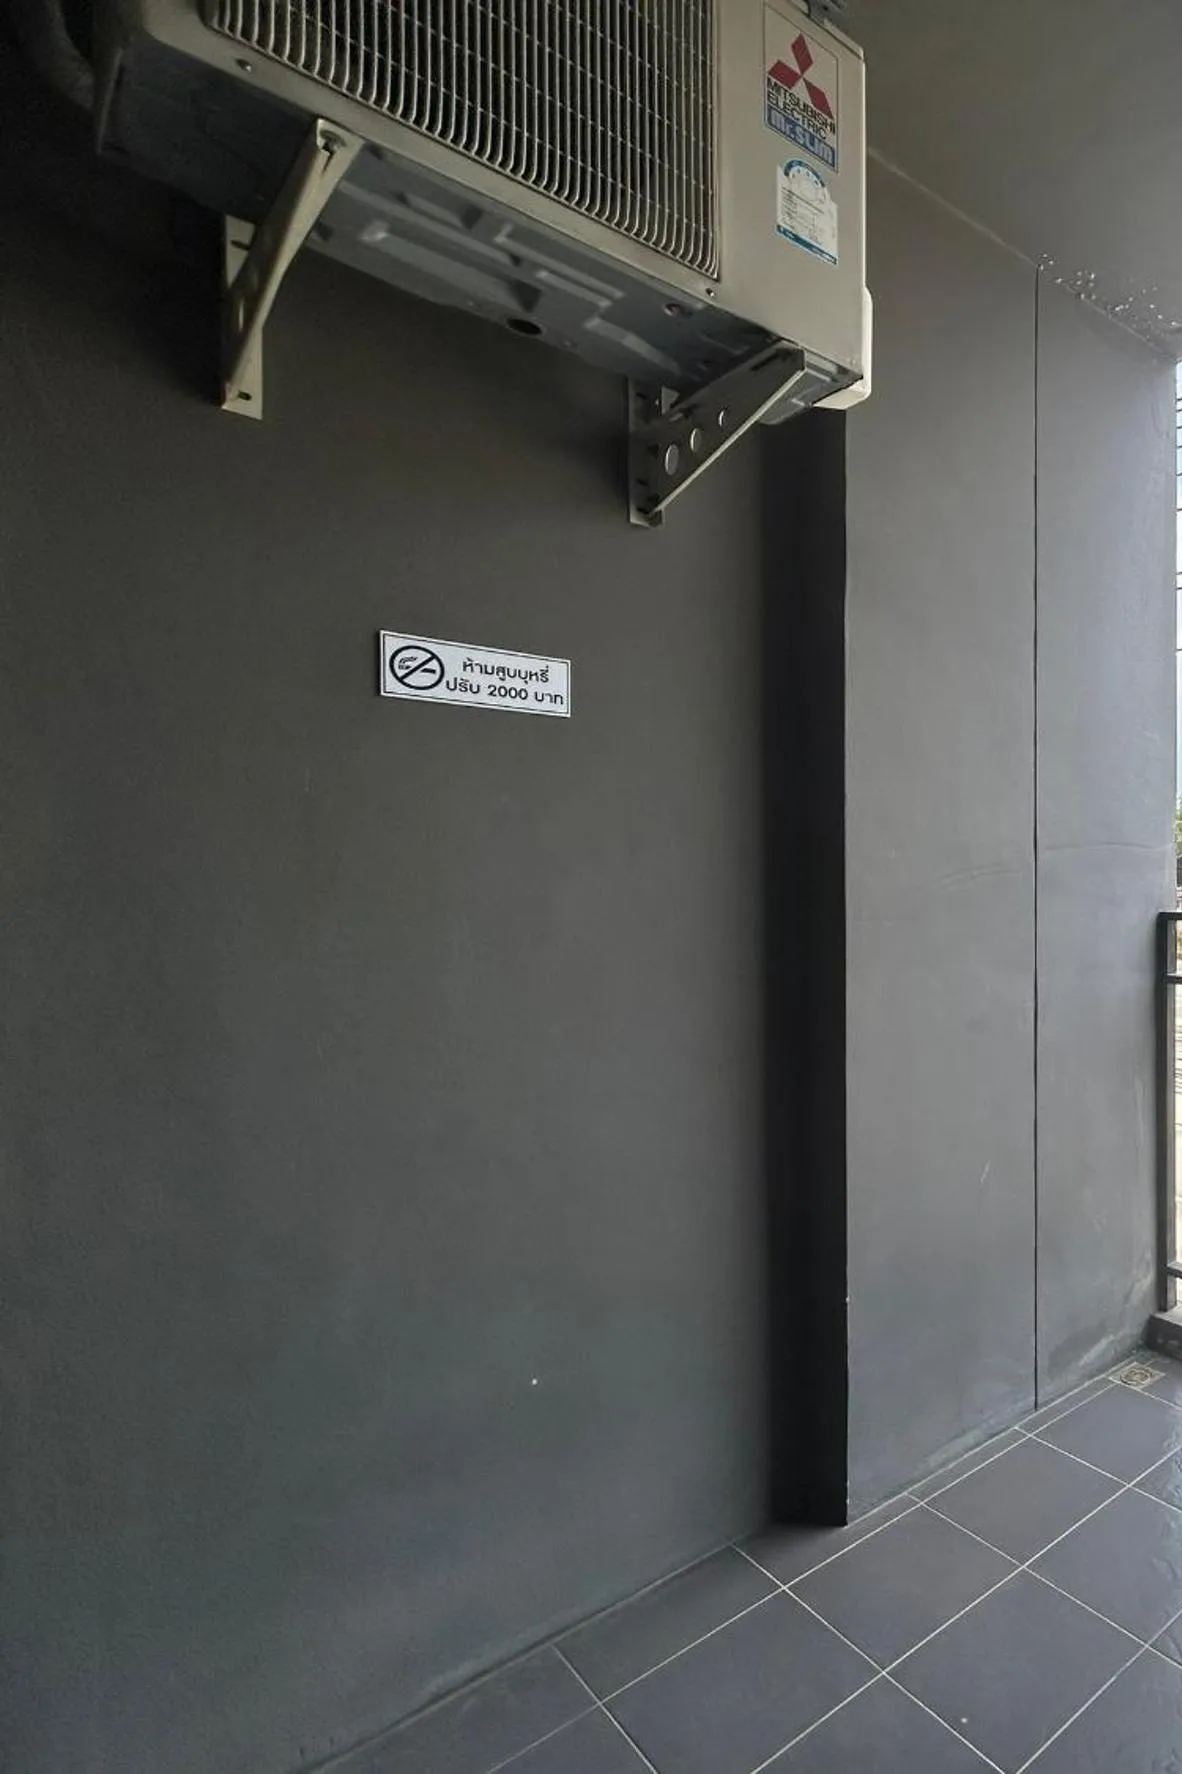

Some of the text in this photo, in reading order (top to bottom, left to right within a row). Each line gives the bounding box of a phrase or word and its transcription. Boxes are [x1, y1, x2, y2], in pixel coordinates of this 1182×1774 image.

[767, 76, 836, 135] MITSUBISHI
[767, 90, 827, 140] ELECTRIC
[462, 657, 549, 684] ห้ามสูบบุหรี่
[445, 677, 564, 705] ปรับ 2000 บาท
